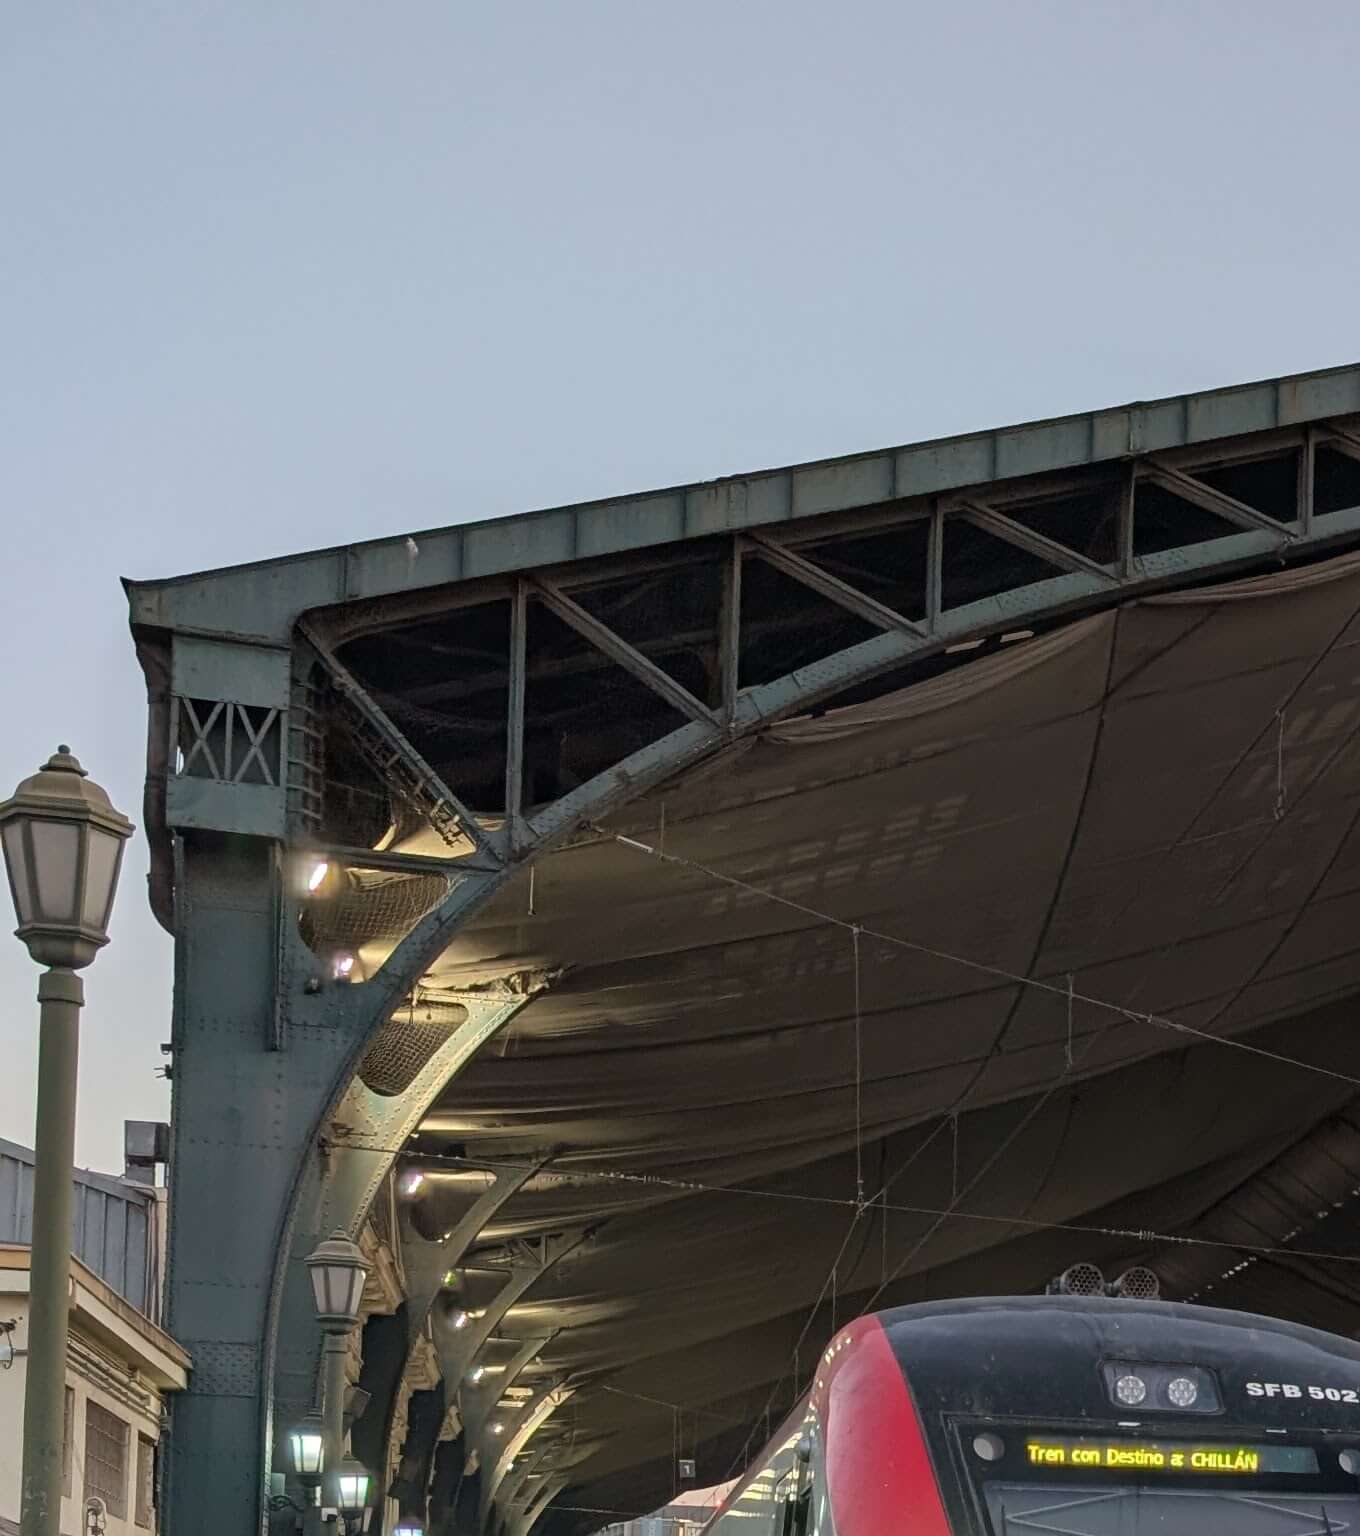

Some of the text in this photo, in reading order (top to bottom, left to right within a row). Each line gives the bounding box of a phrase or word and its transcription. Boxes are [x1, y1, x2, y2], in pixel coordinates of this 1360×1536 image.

[1246, 1382, 1360, 1404] SFB 502
[1027, 1445, 1065, 1463] Tren
[1071, 1449, 1100, 1464] con
[1106, 1448, 1164, 1467] Destino
[1191, 1449, 1258, 1472] CHILLÁN
